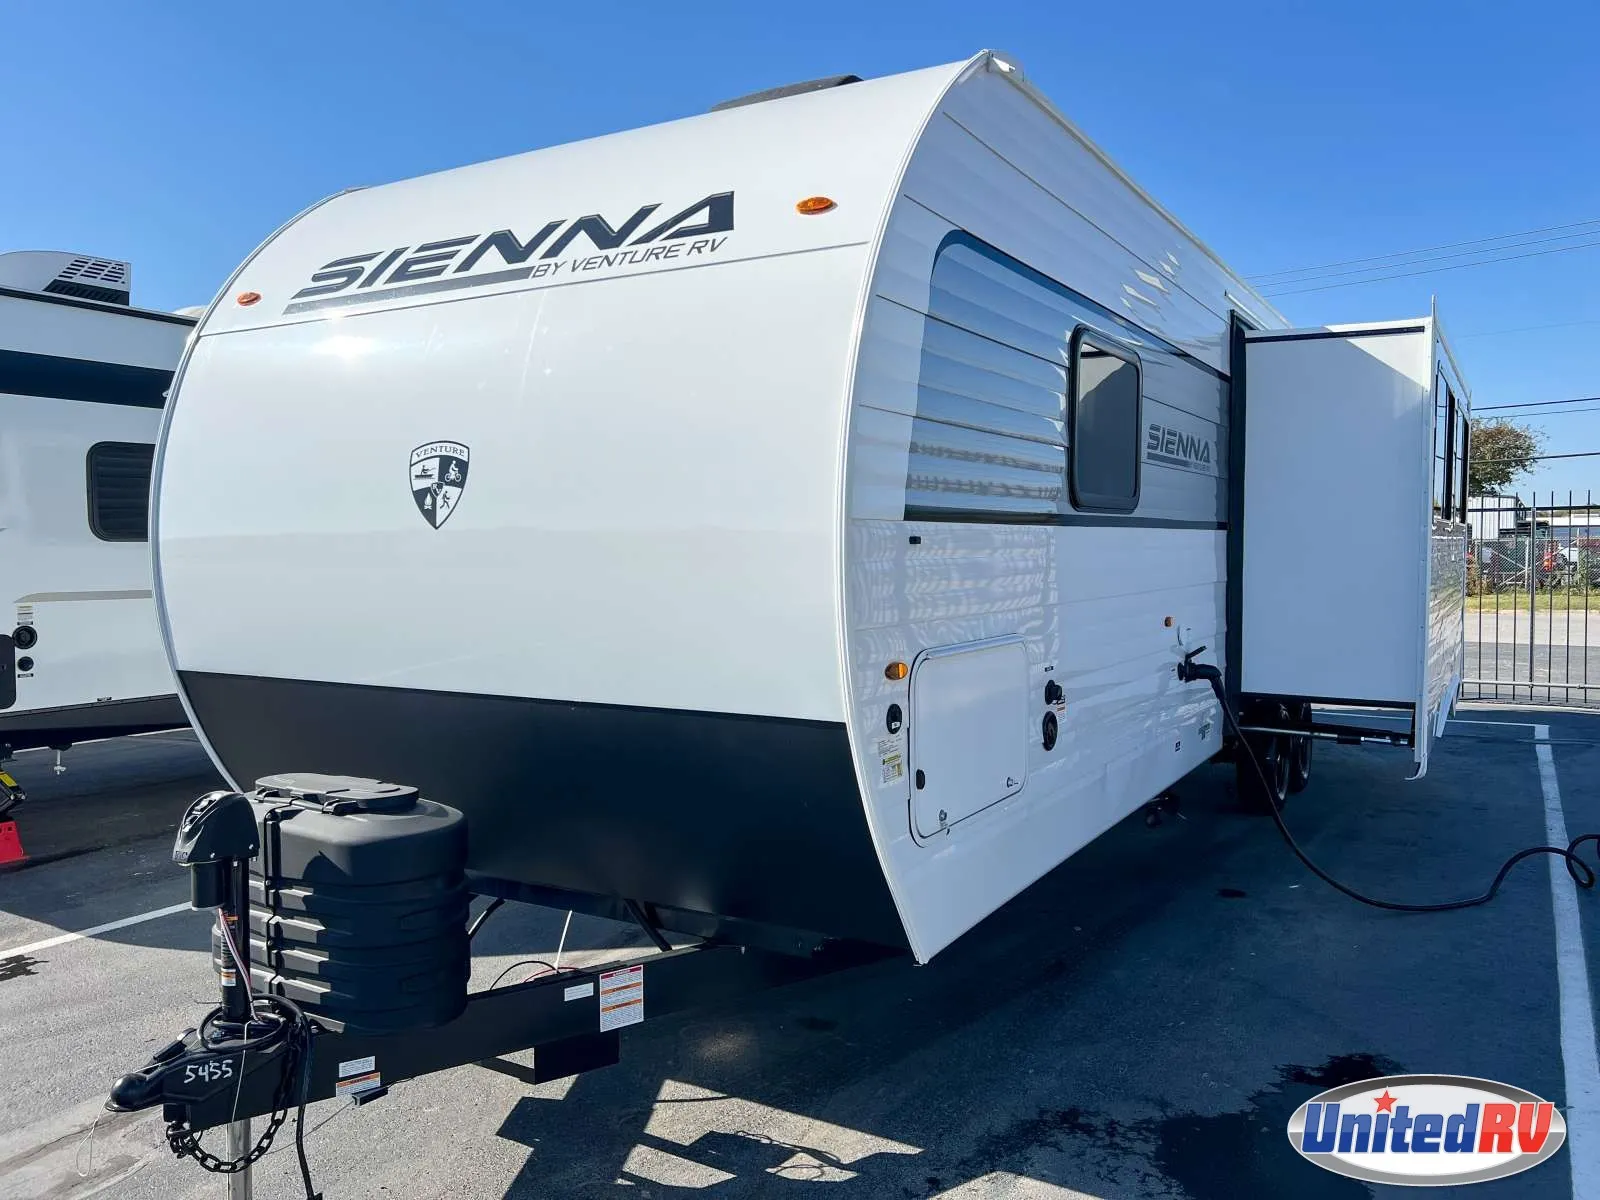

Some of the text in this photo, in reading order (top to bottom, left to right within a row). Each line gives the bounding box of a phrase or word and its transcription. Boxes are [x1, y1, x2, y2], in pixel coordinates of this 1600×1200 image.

[290, 190, 735, 300] SIENNA
[531, 236, 728, 279] BY VENTURE RV
[415, 445, 465, 458] VENTURE
[1146, 423, 1211, 464] SIENNA
[183, 1059, 233, 1084] 5455
